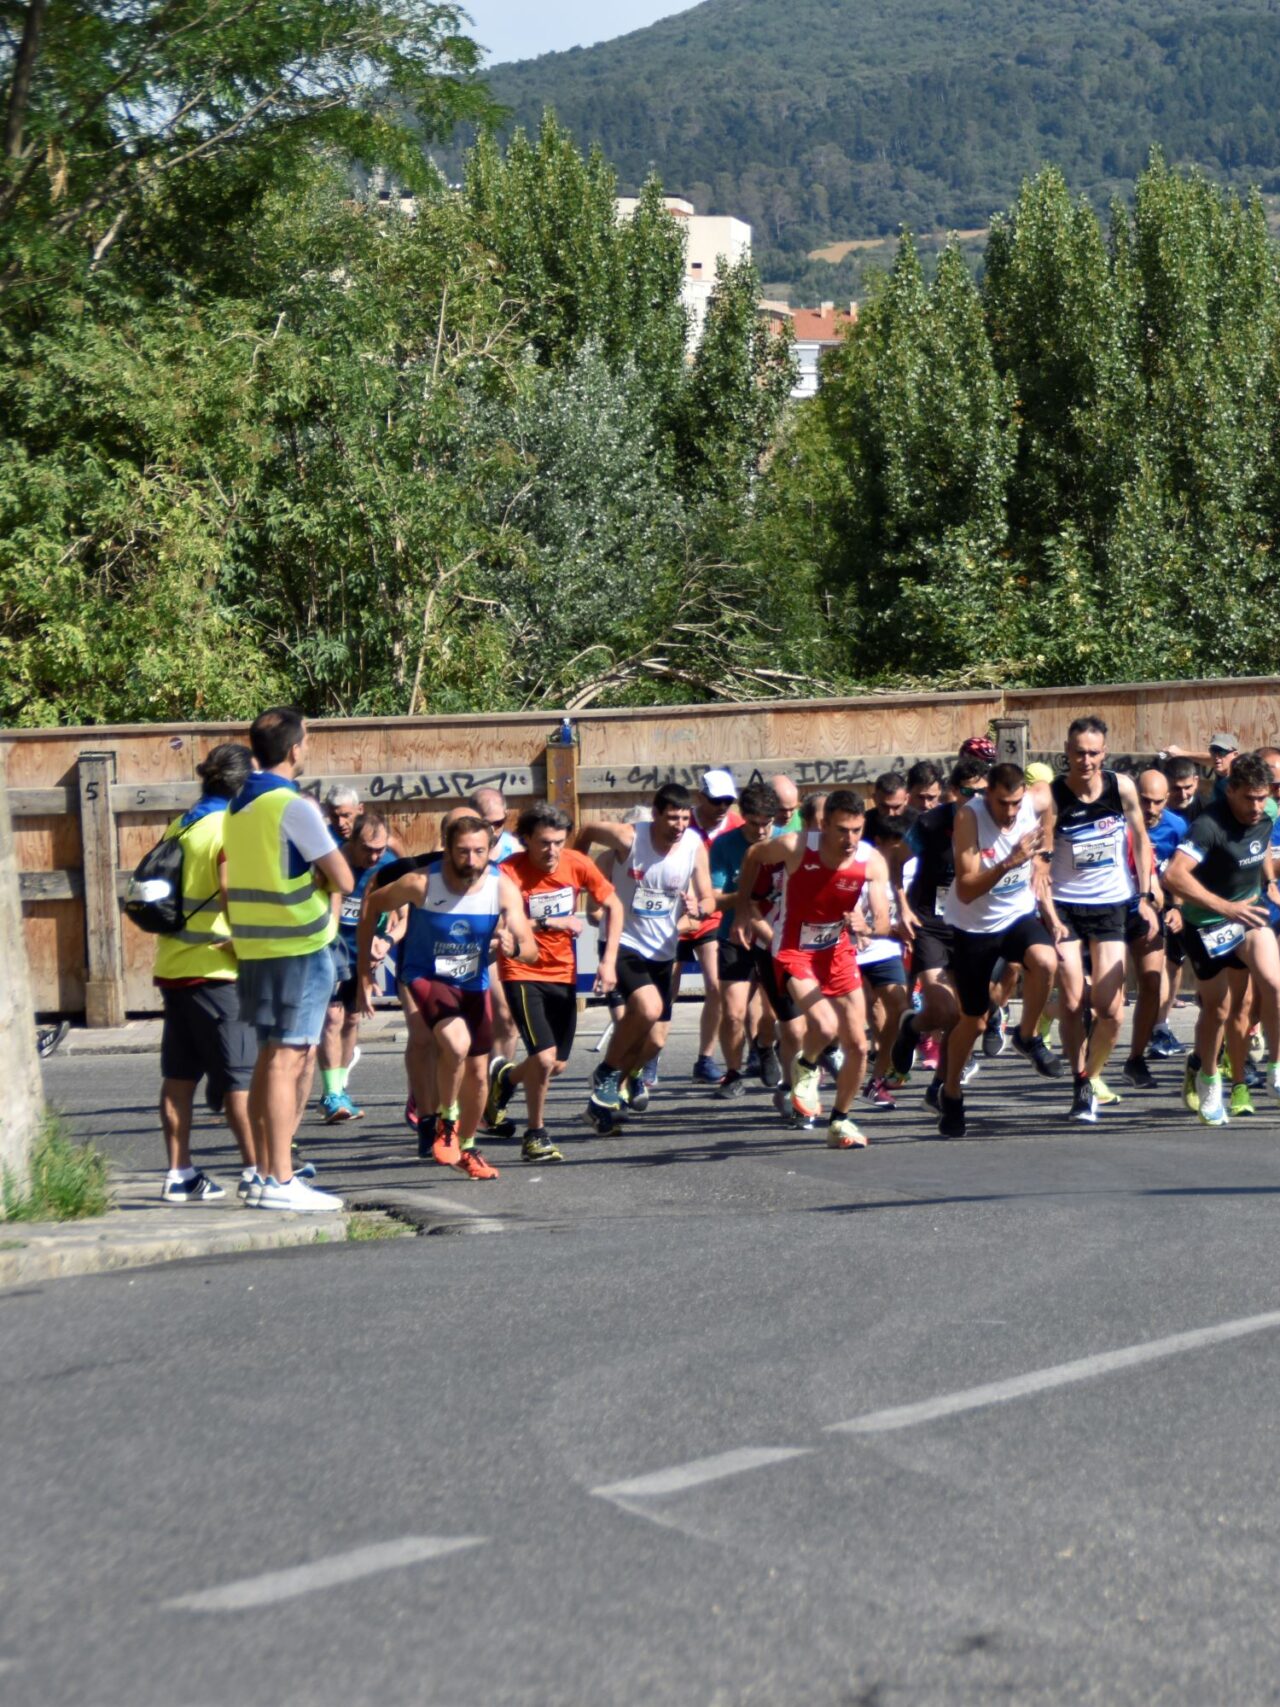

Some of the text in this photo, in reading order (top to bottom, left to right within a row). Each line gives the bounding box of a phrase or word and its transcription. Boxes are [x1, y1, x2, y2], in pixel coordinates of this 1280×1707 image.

[1004, 740, 1016, 753] 3
[604, 770, 616, 788] 4
[85, 782, 99, 800] 5
[136, 790, 147, 805] 5
[1087, 851, 1103, 863] 27
[1003, 874, 1020, 887] 92
[543, 902, 561, 916] 81
[645, 900, 663, 911] 95
[1216, 929, 1235, 945] 63
[450, 964, 468, 978] 30
